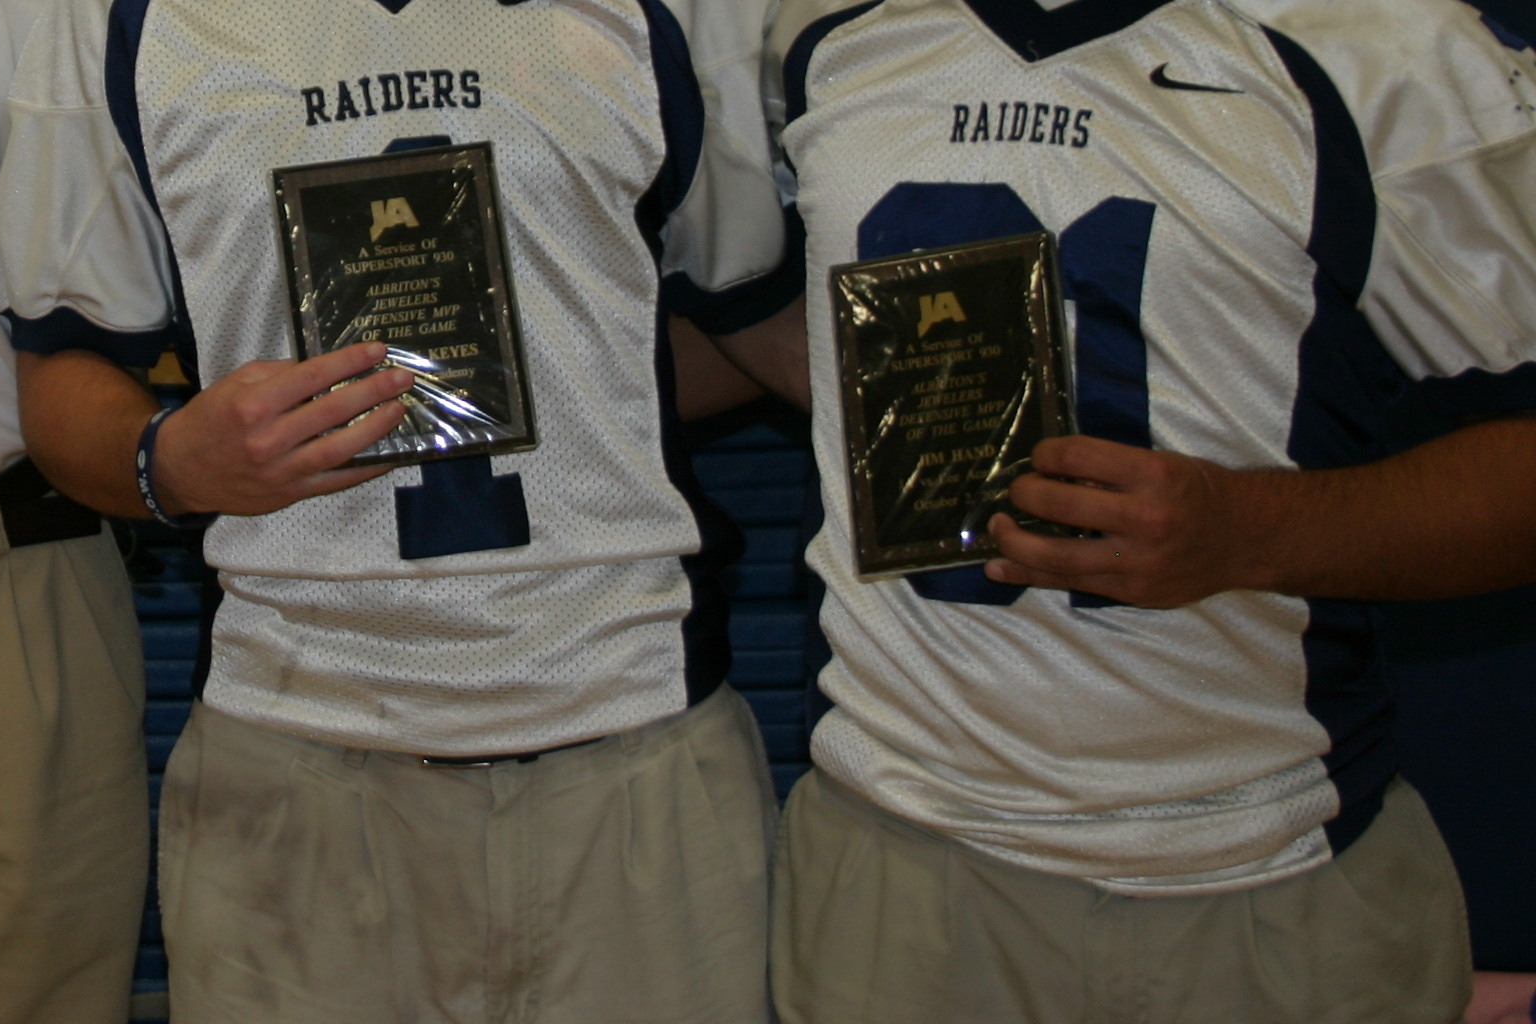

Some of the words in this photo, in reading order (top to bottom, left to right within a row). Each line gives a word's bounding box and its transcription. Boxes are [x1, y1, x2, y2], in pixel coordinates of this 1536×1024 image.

[302, 69, 482, 126] RAIDERS
[950, 101, 1093, 148] RAIDERS
[358, 246, 369, 258] A
[374, 241, 416, 257] Service
[421, 237, 438, 250] Of
[344, 253, 427, 275] SUPERSPORT
[432, 250, 455, 264] 930
[366, 276, 441, 297] ALBRITON'S
[372, 292, 439, 311] JEWELERS
[354, 308, 426, 328] OFFENSIVE
[432, 304, 461, 319] MVP
[362, 329, 381, 342] OF
[387, 325, 413, 339] THE
[419, 319, 457, 335] GAME
[428, 343, 479, 361] KEYES
[906, 343, 916, 355] A
[967, 331, 985, 345] Of
[890, 348, 974, 372] SUPERSPORT
[430, 366, 476, 380] cademy
[905, 427, 926, 441] OF
[932, 423, 958, 437] THE
[951, 444, 995, 463] HAND
